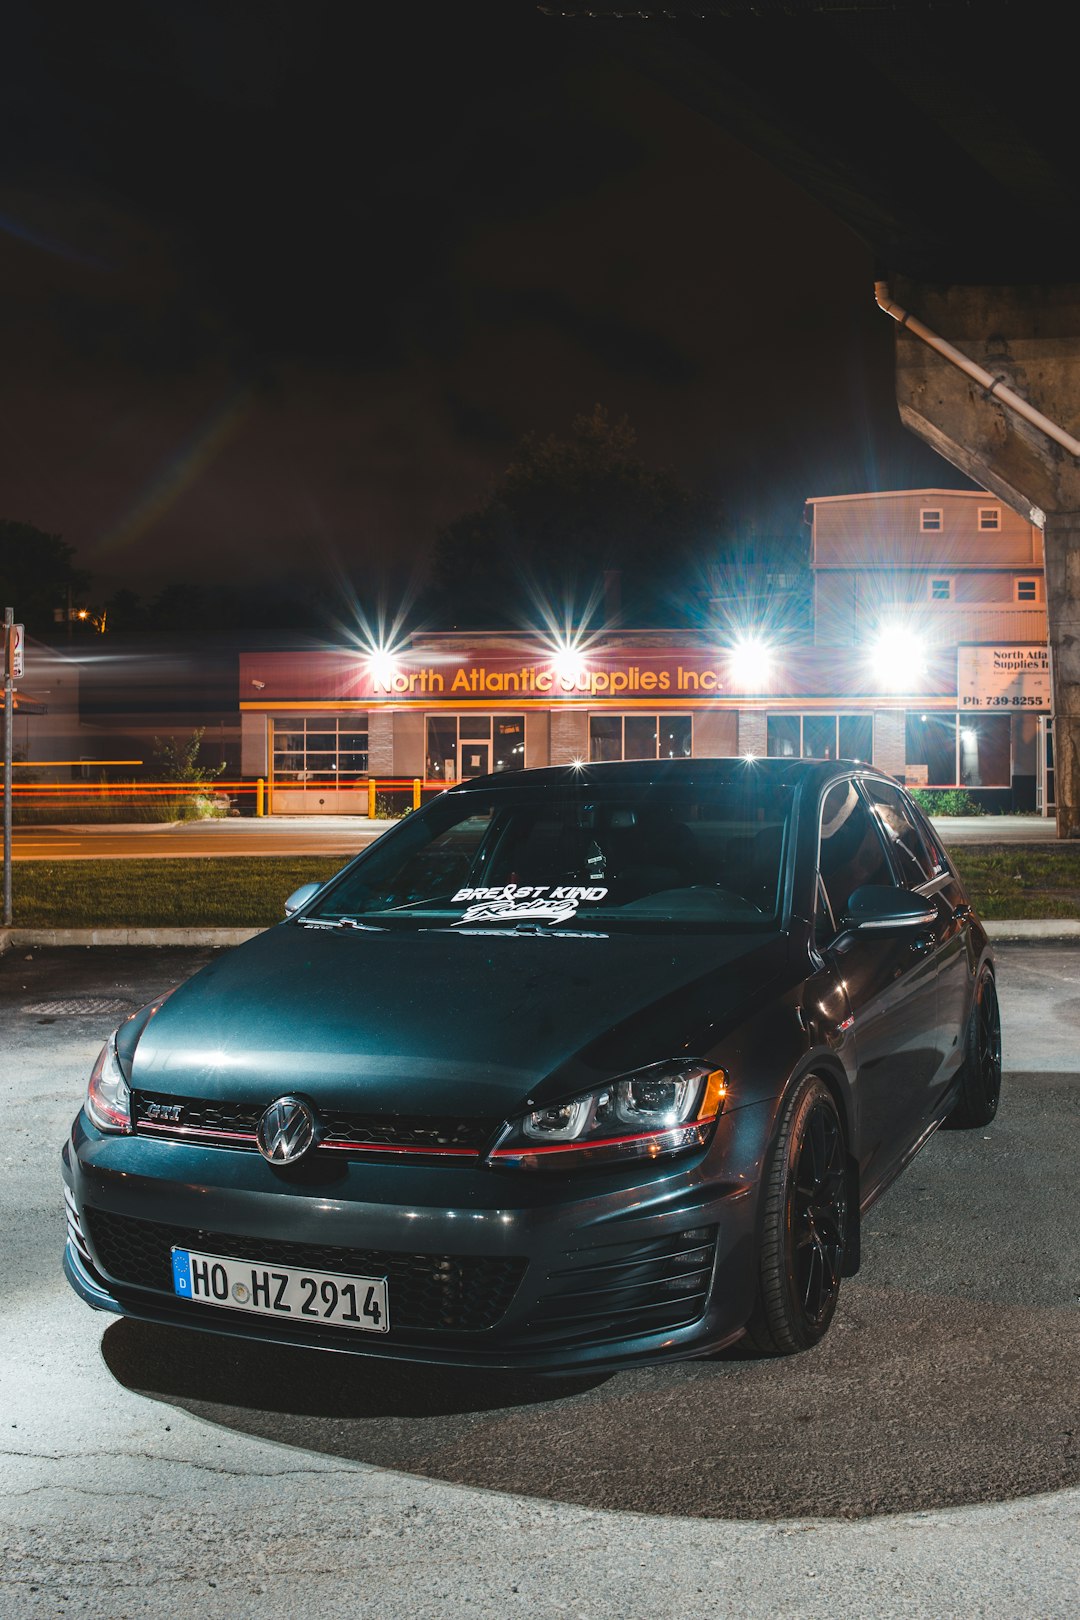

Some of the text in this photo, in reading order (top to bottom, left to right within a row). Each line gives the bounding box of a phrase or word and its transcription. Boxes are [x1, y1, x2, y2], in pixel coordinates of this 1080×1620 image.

[993, 651, 1024, 659] North
[993, 660, 1039, 670] Supplies
[373, 666, 724, 696] North Atlantic Supplies Inc.
[963, 696, 982, 705] Ph:
[986, 696, 1043, 706] 739-8255
[549, 886, 609, 901] KIND
[147, 1103, 181, 1122] GTI
[179, 1277, 187, 1290] D
[191, 1258, 382, 1325] HO HZ 2914
